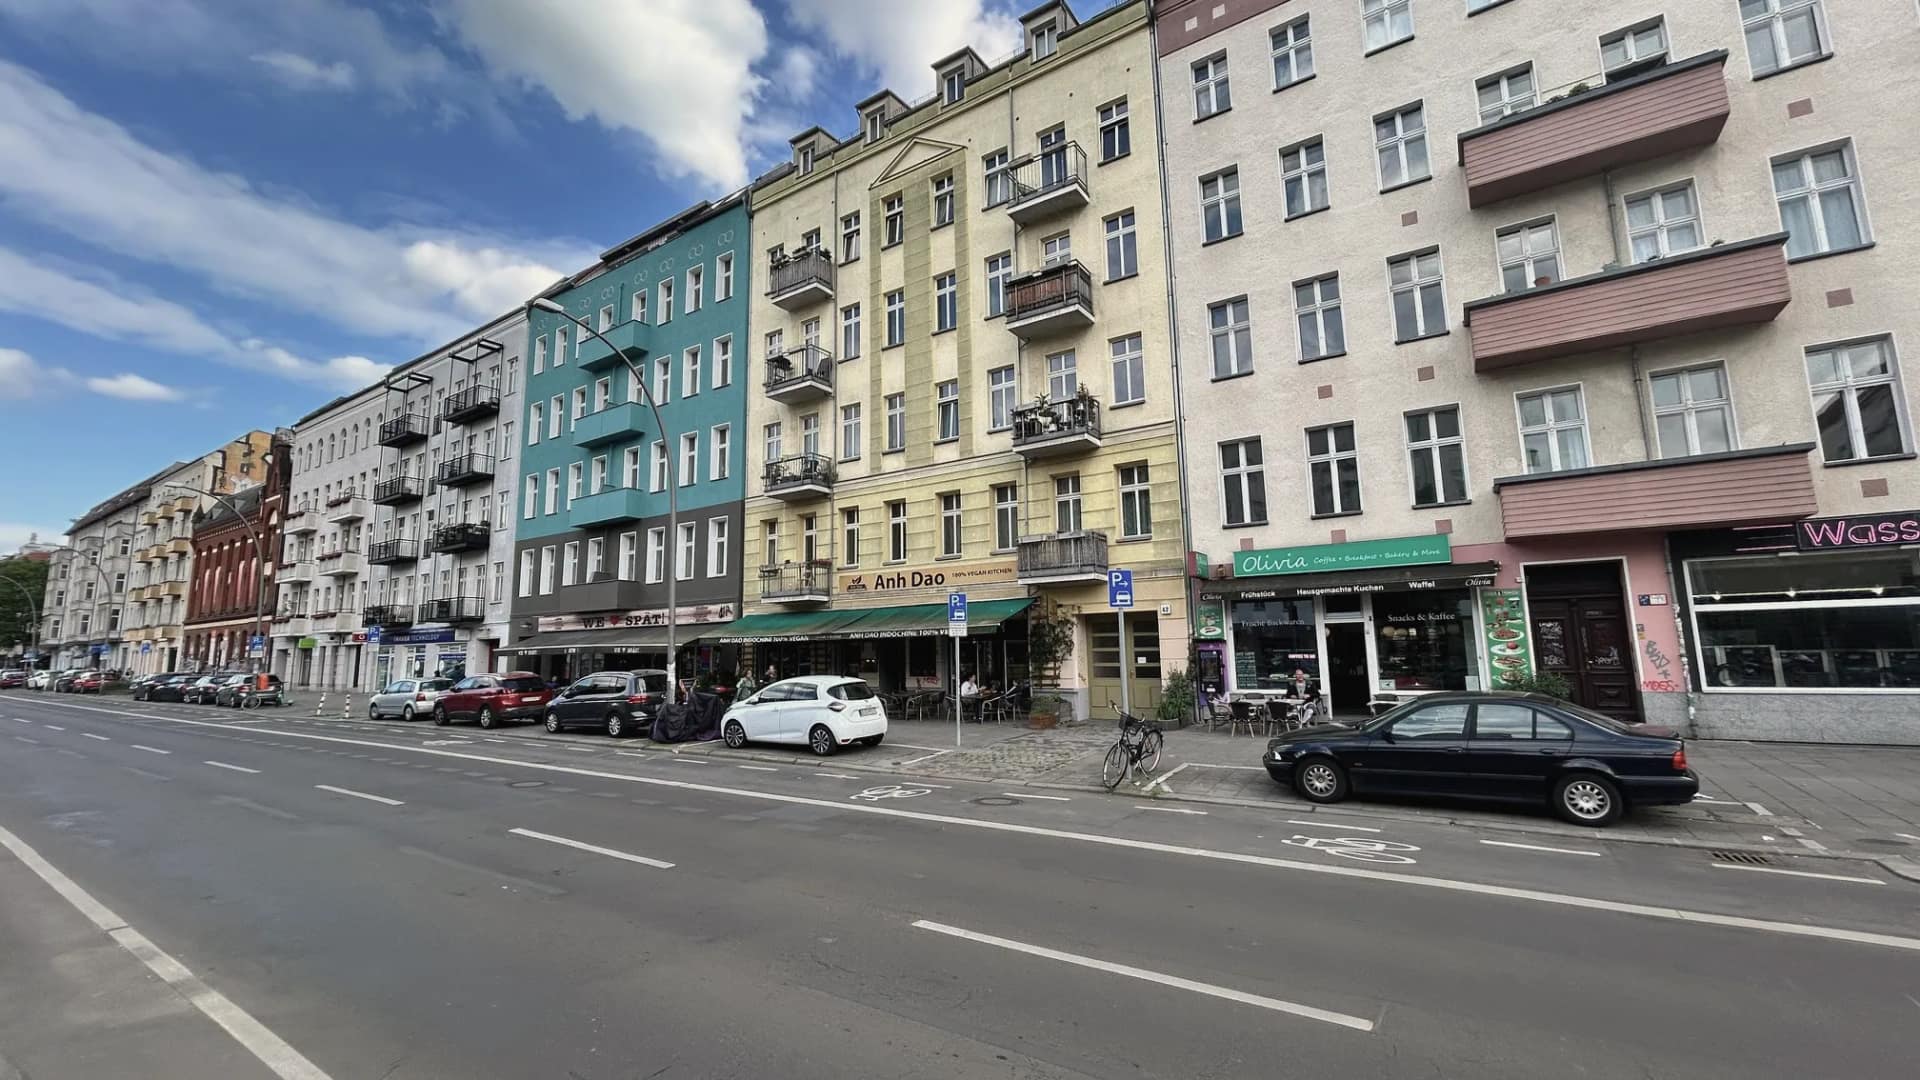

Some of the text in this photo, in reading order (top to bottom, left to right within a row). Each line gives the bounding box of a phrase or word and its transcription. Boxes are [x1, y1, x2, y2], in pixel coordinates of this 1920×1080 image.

[1242, 553, 1308, 572] Olivia
[874, 572, 906, 590] Anh
[911, 572, 945, 586] Dao
[1112, 572, 1122, 587] P
[1408, 580, 1435, 589] Waffel
[1465, 578, 1491, 587] Olivia
[1241, 590, 1276, 599] Frühstück
[1296, 583, 1384, 596] Hausgemachte Kuchen
[951, 596, 959, 606] P
[582, 616, 604, 628] WE
[1387, 612, 1456, 622] Snacks & Kaffee
